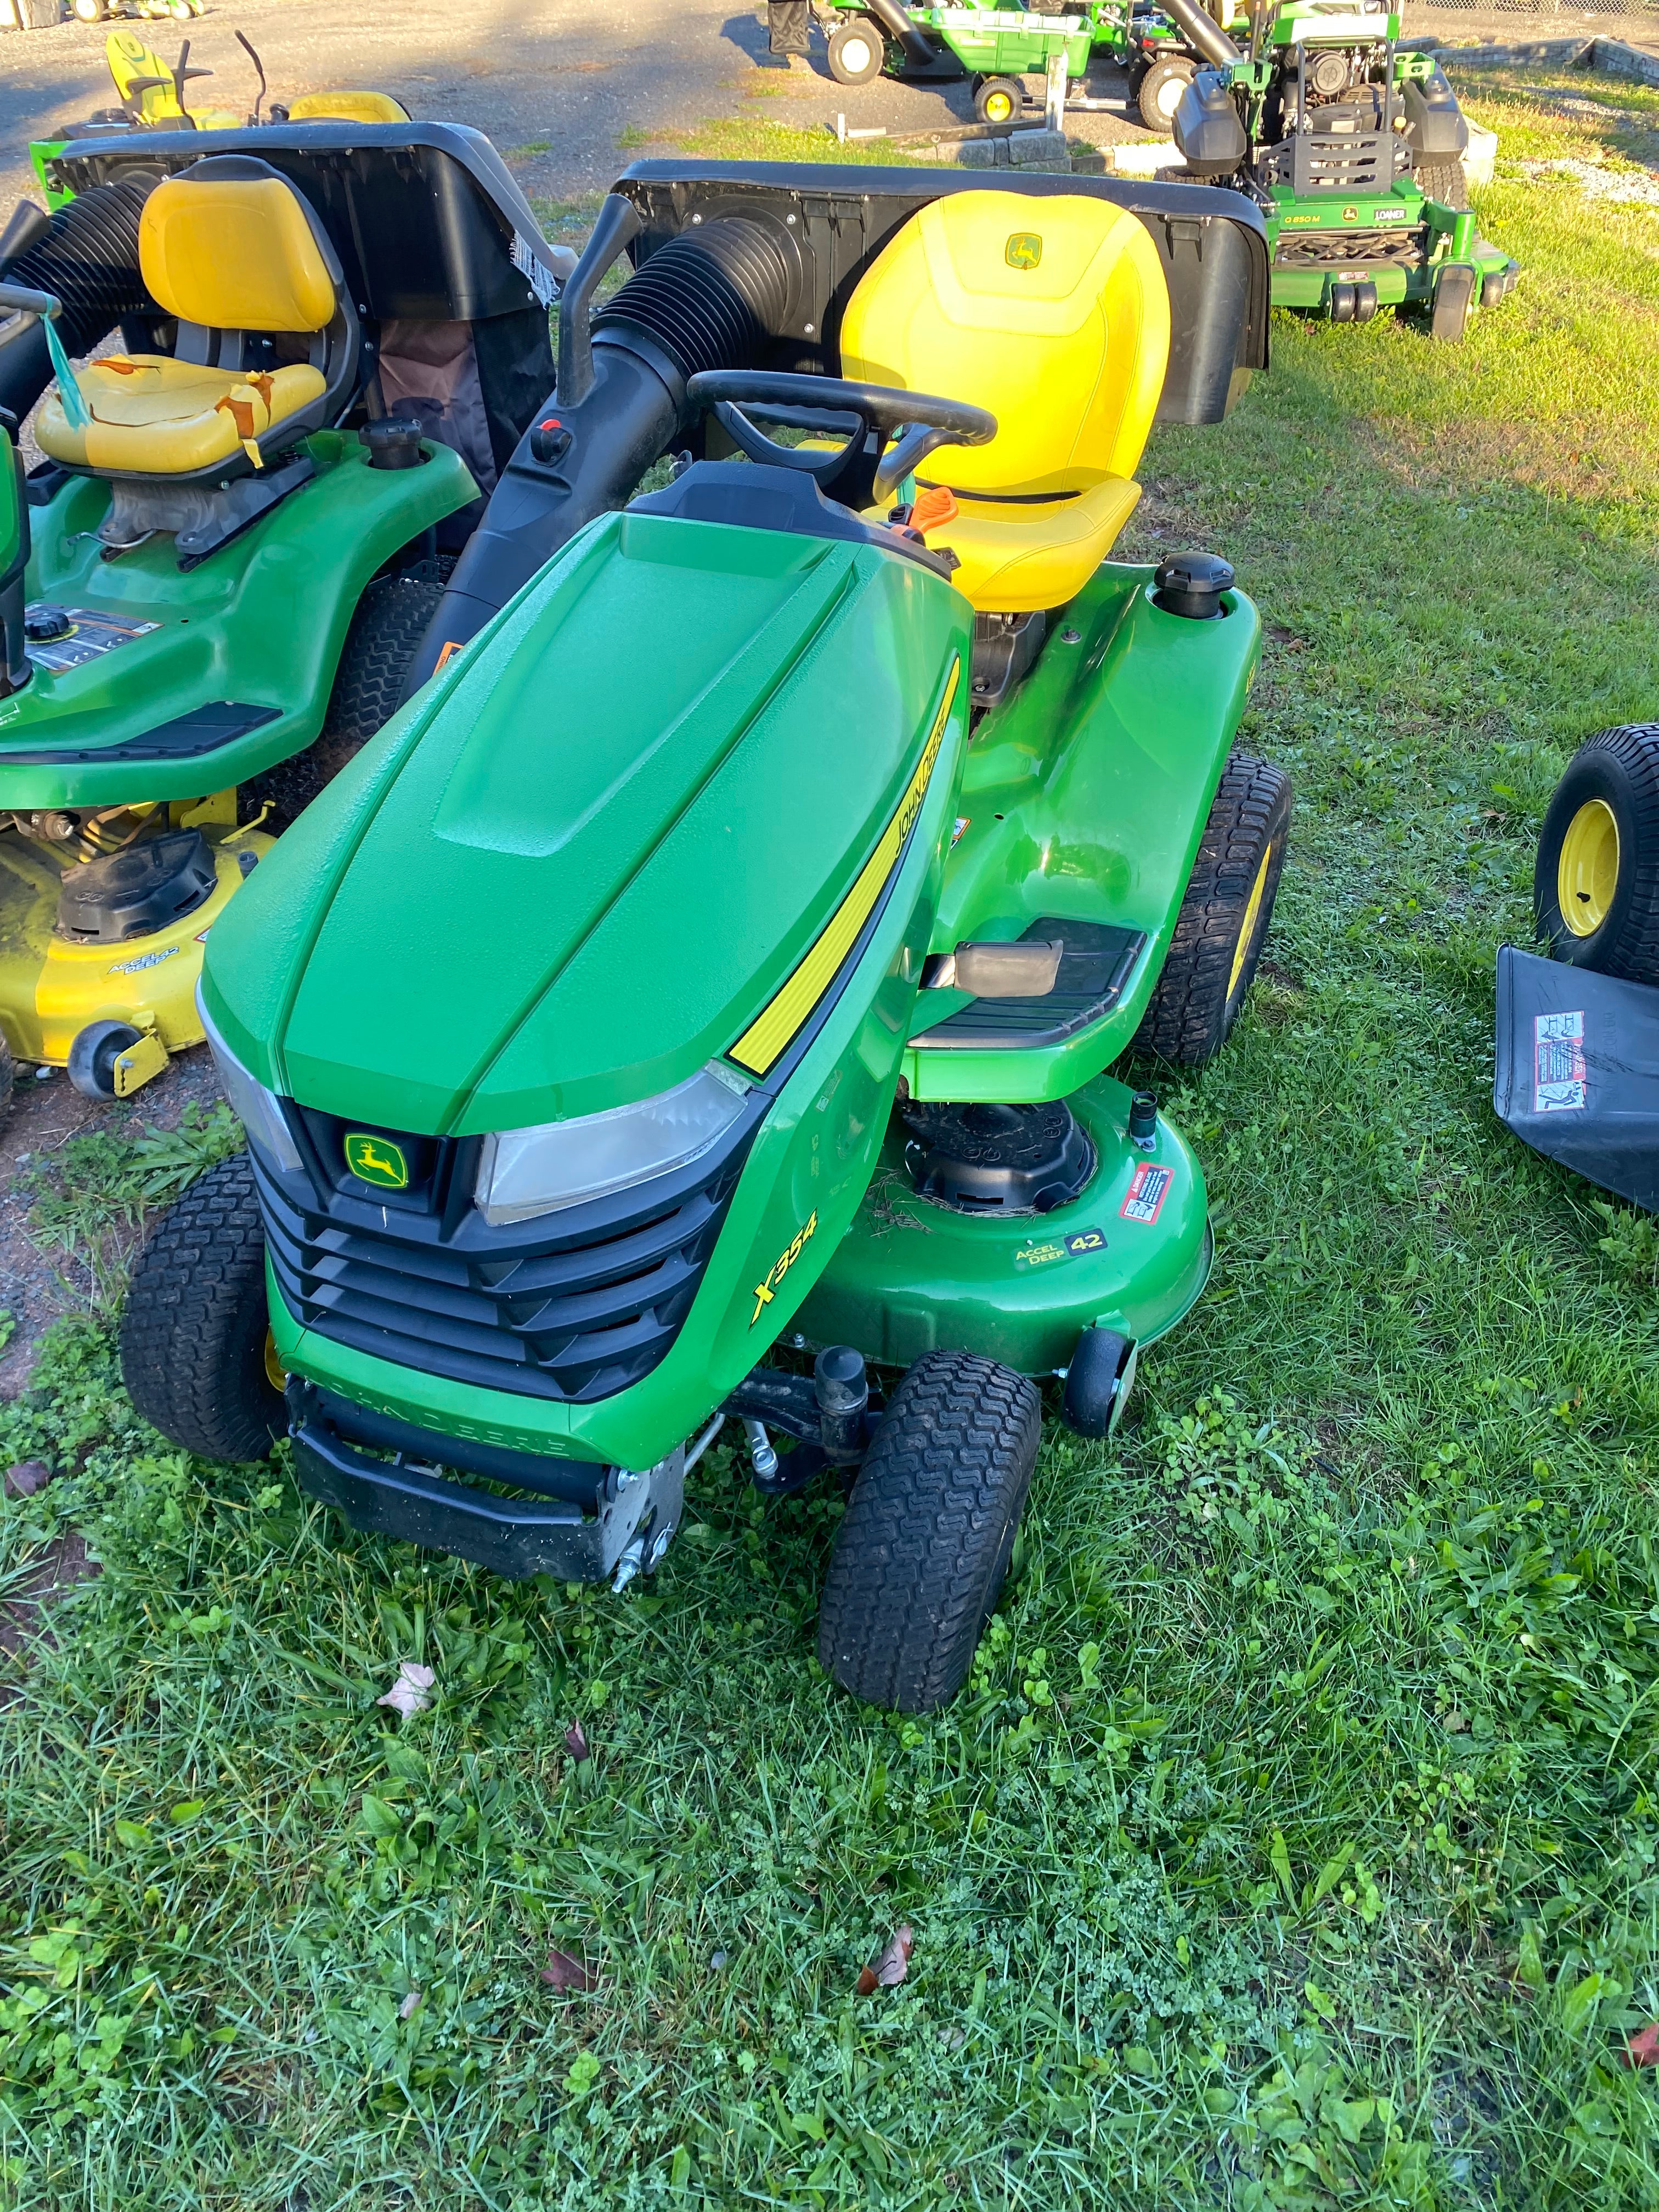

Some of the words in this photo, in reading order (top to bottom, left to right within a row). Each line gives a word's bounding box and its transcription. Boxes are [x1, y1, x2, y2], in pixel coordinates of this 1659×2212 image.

[1375, 210, 1404, 219] LOANER
[896, 778, 921, 855] JOHN
[923, 707, 945, 788] DEERE
[161, 946, 179, 957] 42
[107, 953, 159, 974] ACCEL
[124, 956, 166, 975] DEEP
[1133, 1171, 1144, 1188] DANGER
[1071, 1234, 1103, 1250] 42
[1016, 1245, 1057, 1260] ACCEL
[1029, 1250, 1064, 1265] DEEP
[749, 1207, 818, 1329] X354
[415, 1412, 570, 1457] DEERE
